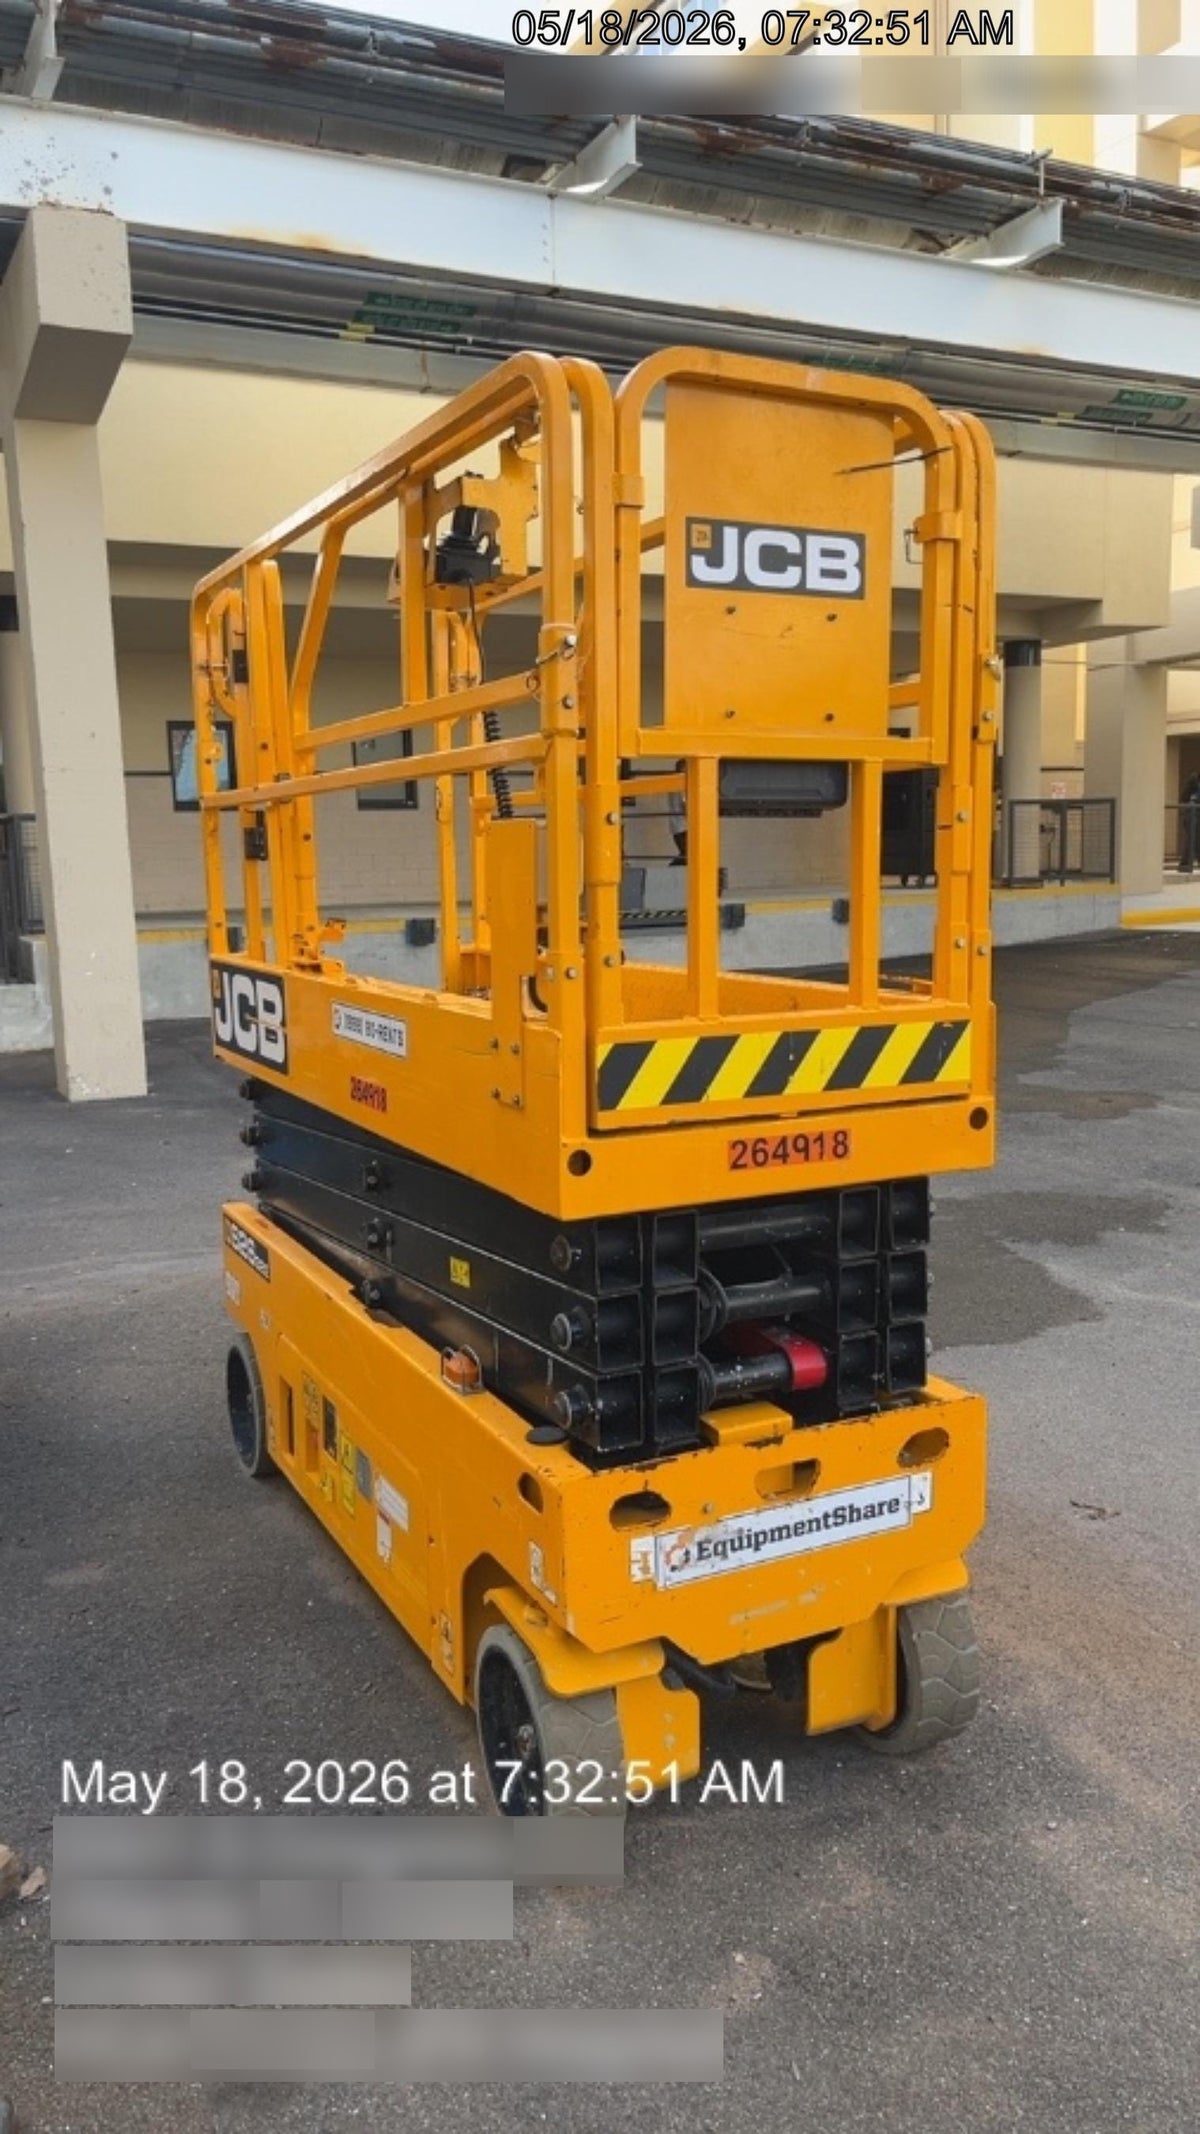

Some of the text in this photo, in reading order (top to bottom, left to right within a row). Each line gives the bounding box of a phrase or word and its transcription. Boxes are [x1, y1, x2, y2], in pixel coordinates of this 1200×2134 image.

[691, 526, 862, 593] JCB
[215, 970, 285, 1063] JCB
[730, 1130, 849, 1171] 264918
[696, 1495, 901, 1562] EquipmentShare
